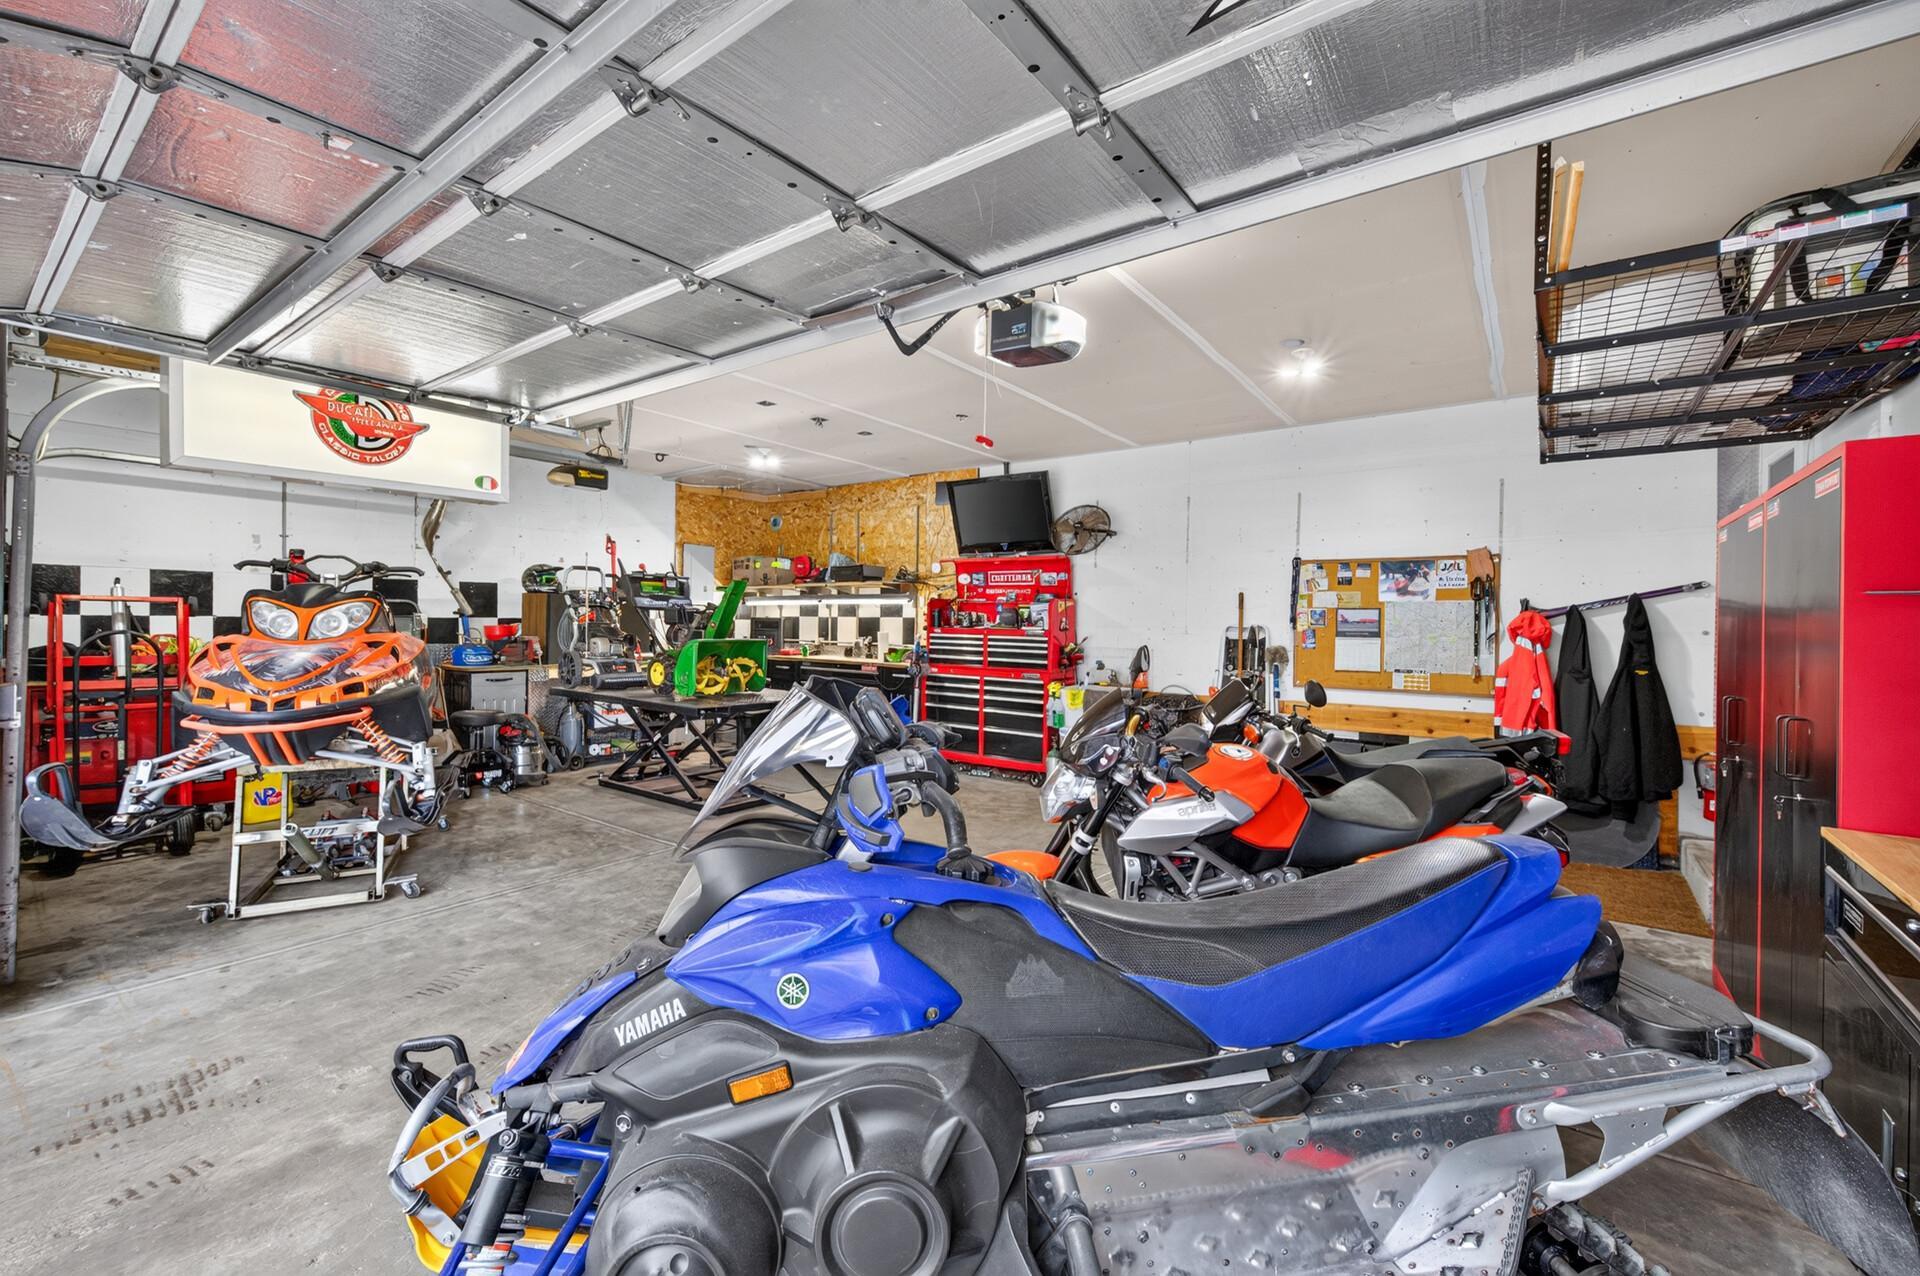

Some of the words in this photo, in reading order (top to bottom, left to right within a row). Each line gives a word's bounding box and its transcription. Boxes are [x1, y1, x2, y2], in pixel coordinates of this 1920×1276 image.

[327, 401, 374, 418] DUCATI
[318, 422, 361, 460] CLASSIC
[613, 997, 687, 1047] YAMAHA
